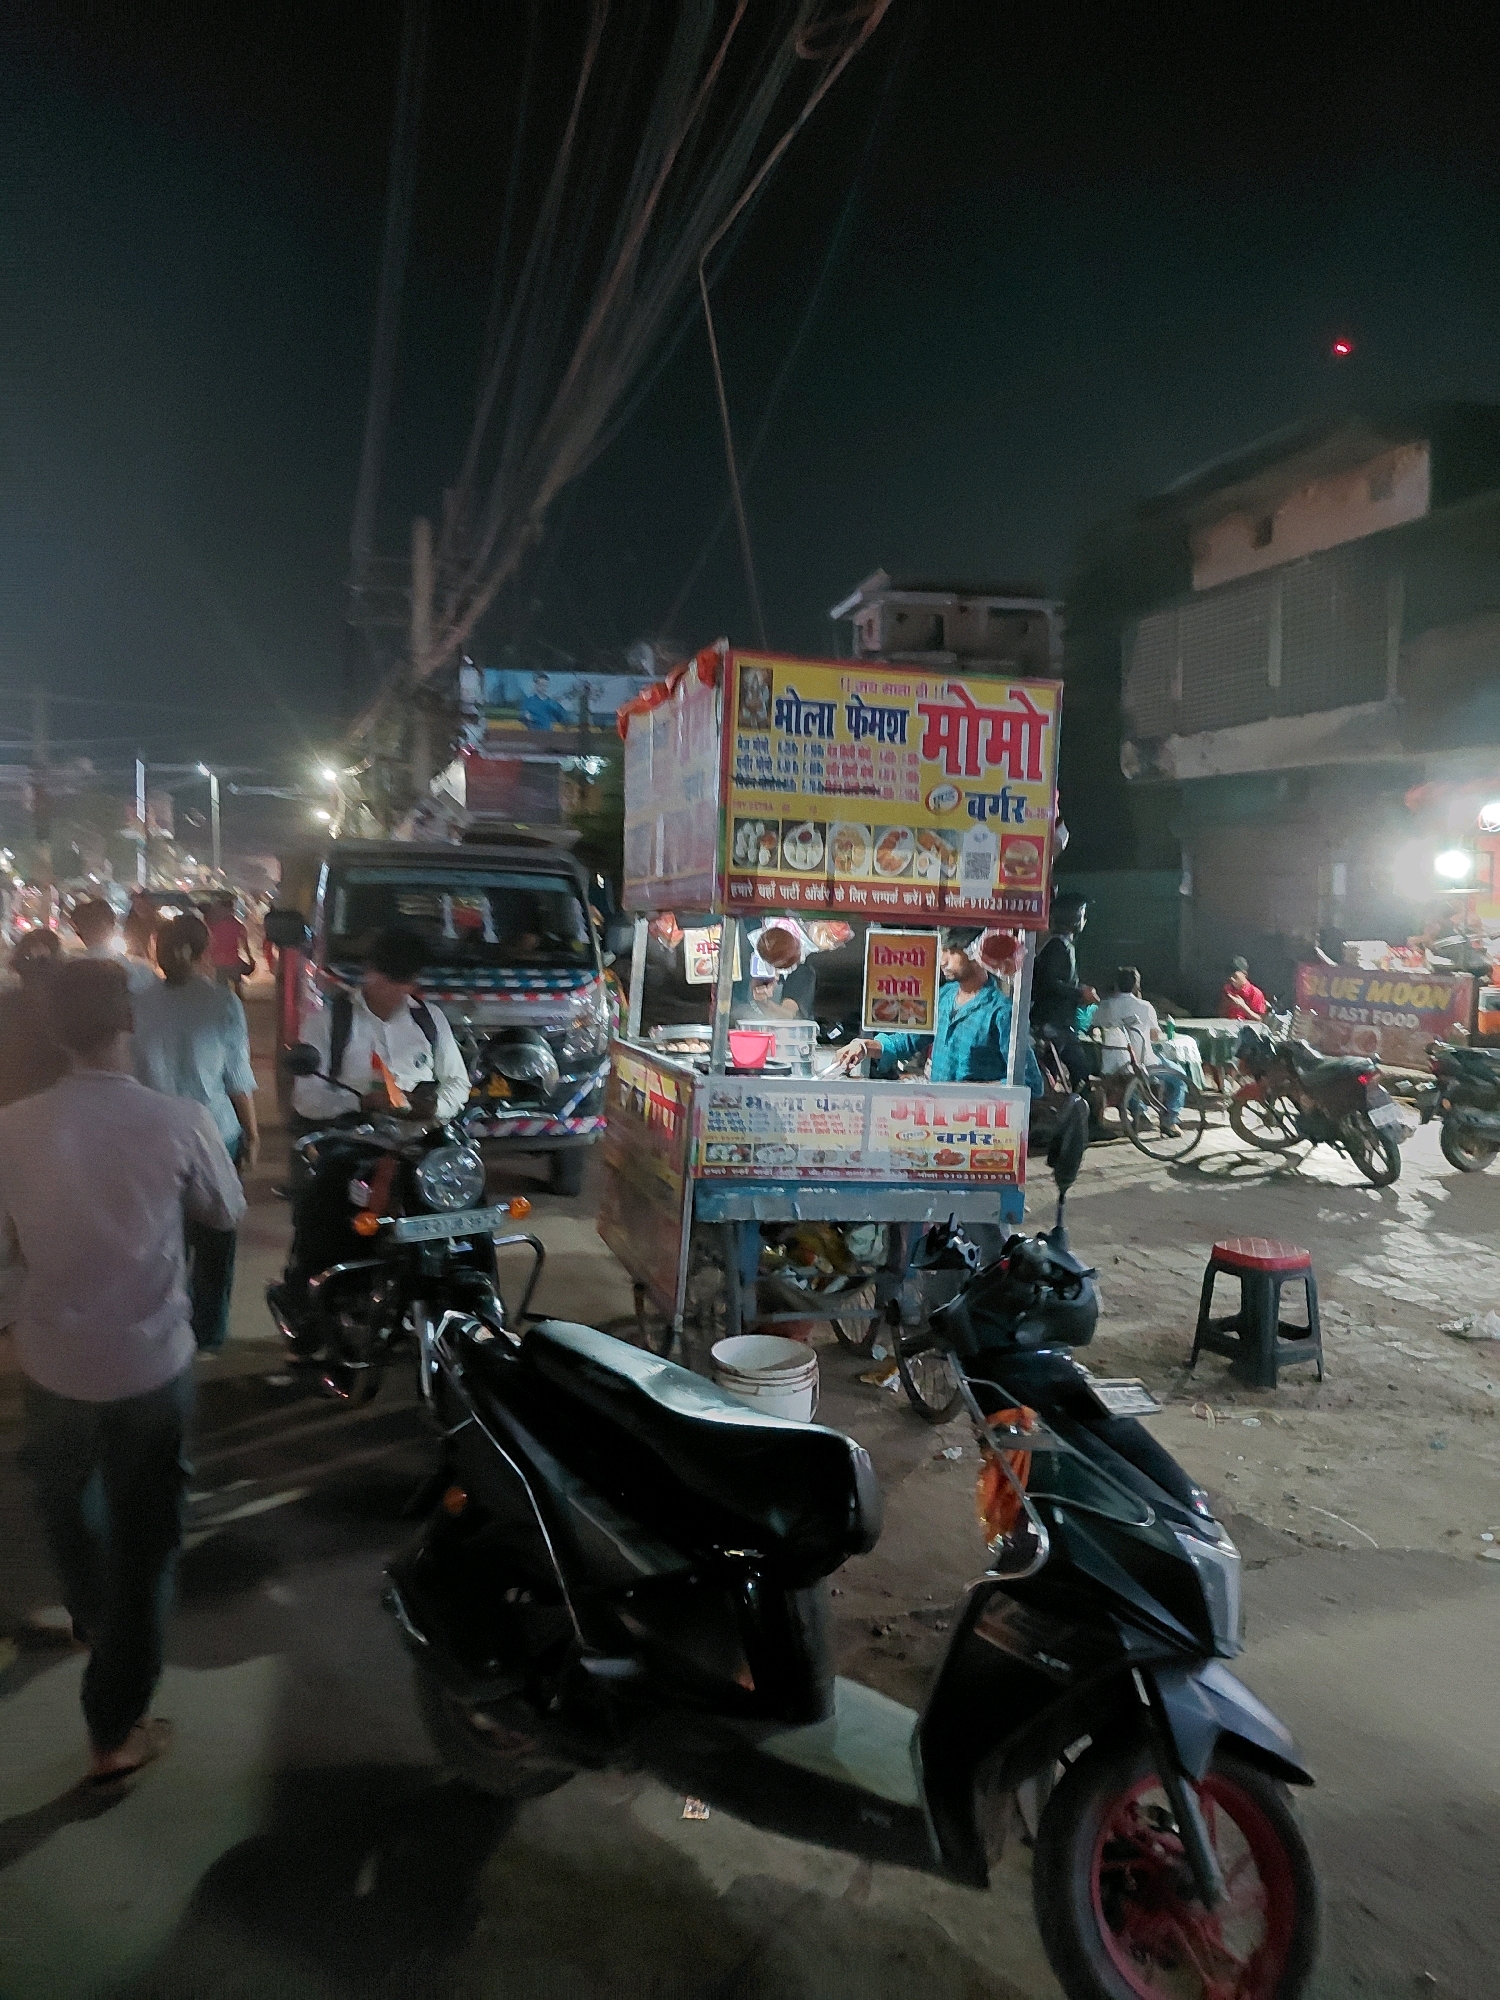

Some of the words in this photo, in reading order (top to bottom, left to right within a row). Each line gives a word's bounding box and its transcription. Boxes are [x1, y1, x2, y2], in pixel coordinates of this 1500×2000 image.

[774, 687, 837, 739] भोला
[918, 684, 1050, 781] मोमो
[877, 974, 920, 996] मोमो
[1366, 979, 1452, 1011] MOON
[1328, 1003, 1369, 1023] FAST
[1372, 1008, 1420, 1029] FOOD
